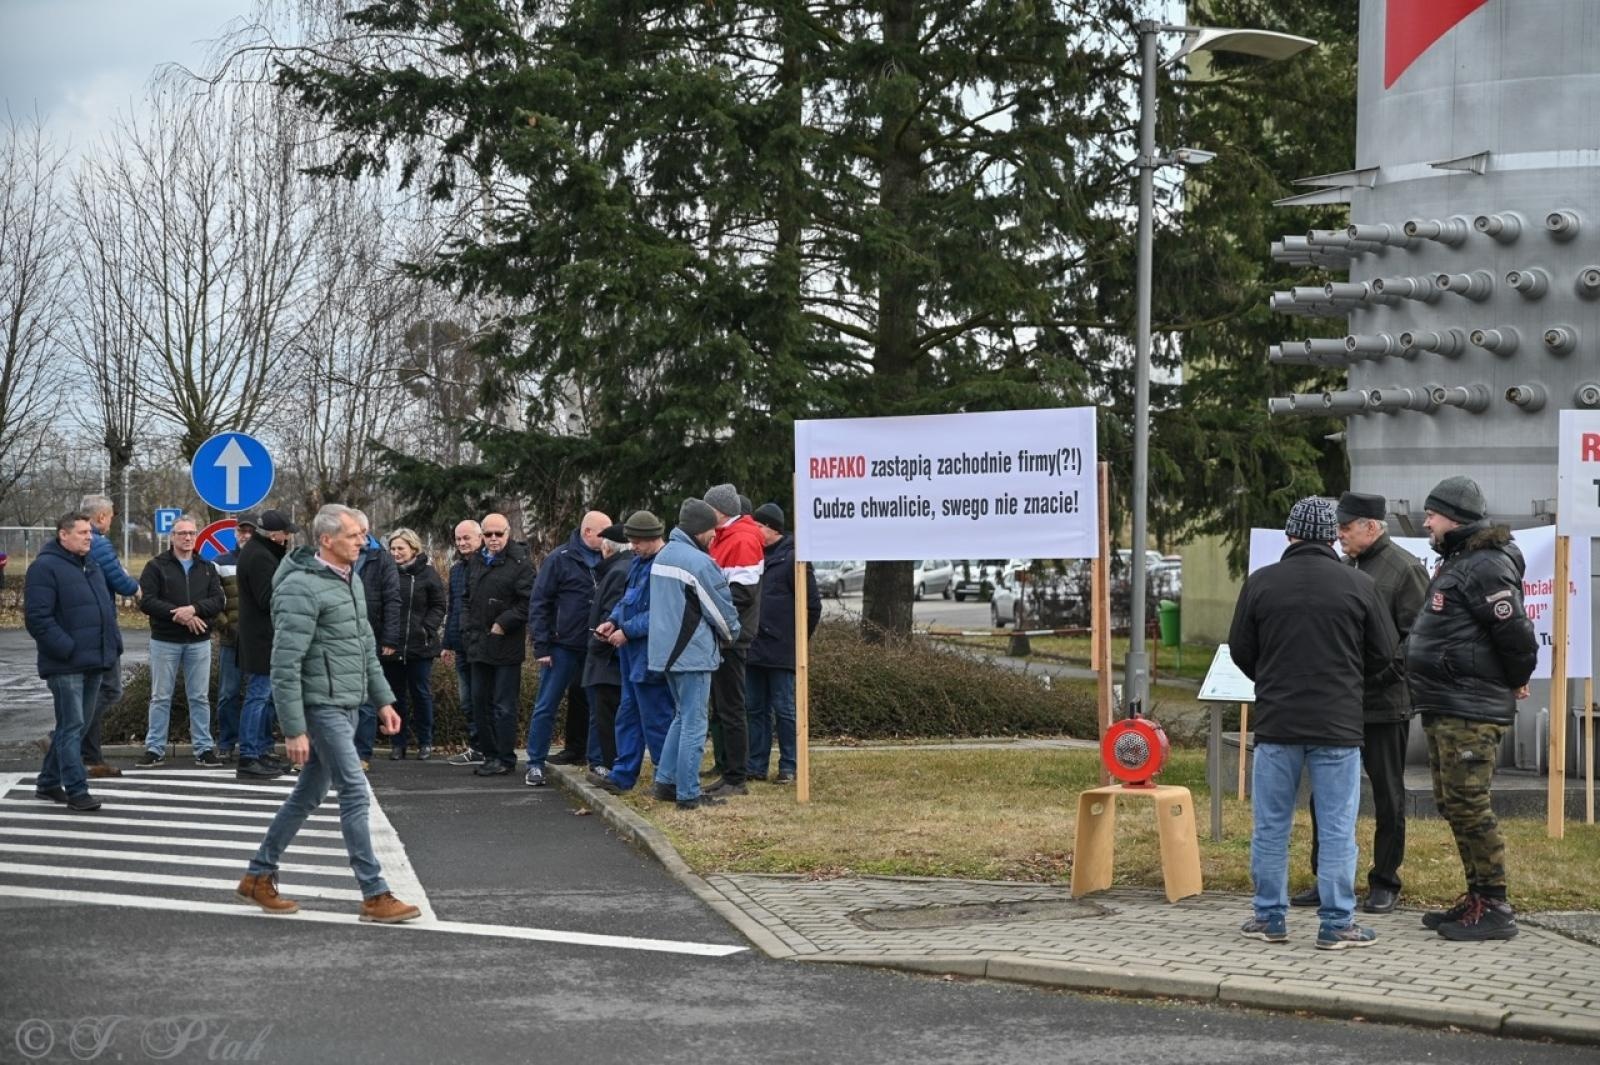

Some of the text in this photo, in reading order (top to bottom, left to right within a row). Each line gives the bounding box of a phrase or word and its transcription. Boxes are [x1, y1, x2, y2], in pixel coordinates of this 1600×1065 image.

[809, 448, 1082, 481] RAFAKO zastąpią zachodnie firmy(?!)
[160, 511, 175, 531] P
[813, 490, 1079, 521] Cudze chwalicie, swego nie znacie!
